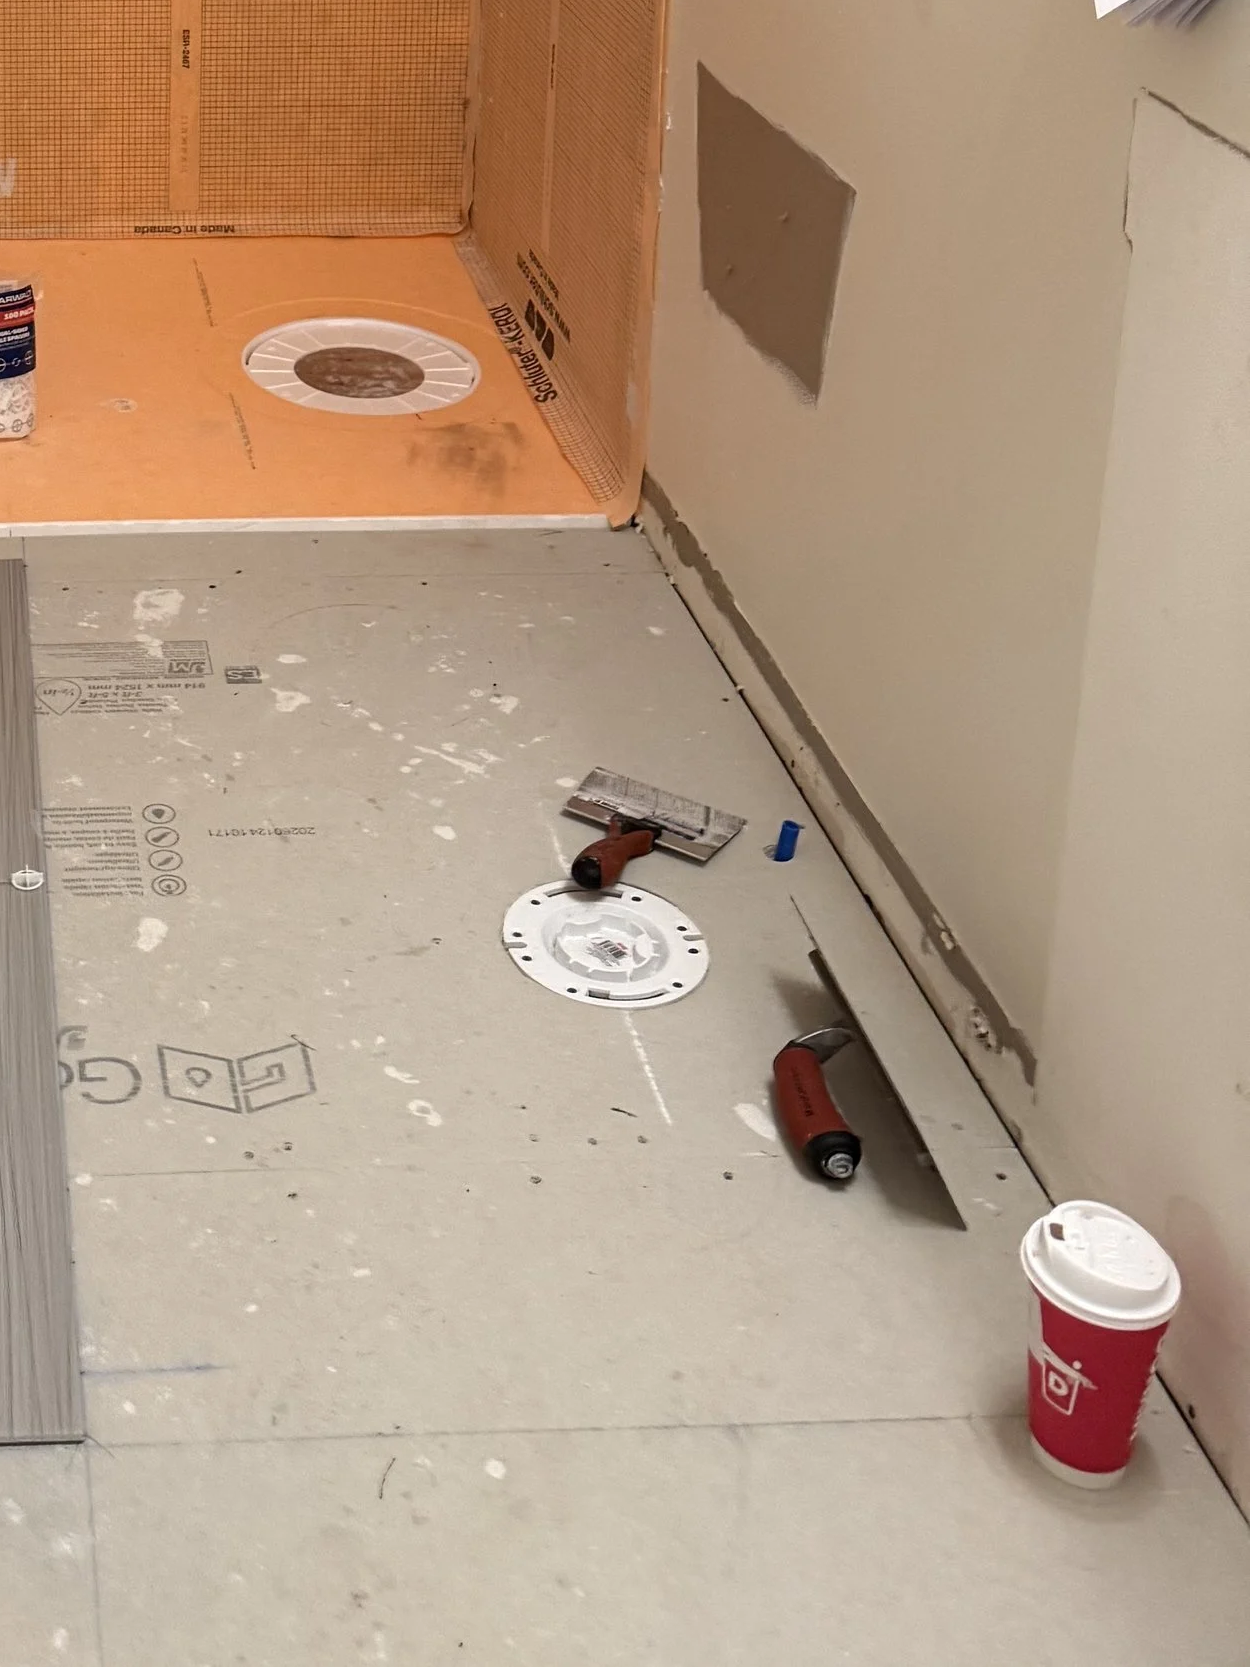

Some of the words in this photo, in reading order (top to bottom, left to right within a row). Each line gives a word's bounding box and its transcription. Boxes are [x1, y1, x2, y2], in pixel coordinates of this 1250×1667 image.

[134, 226, 182, 235] Canada
[186, 225, 197, 233] in
[201, 225, 235, 234] Made
[4, 311, 19, 320] 100
